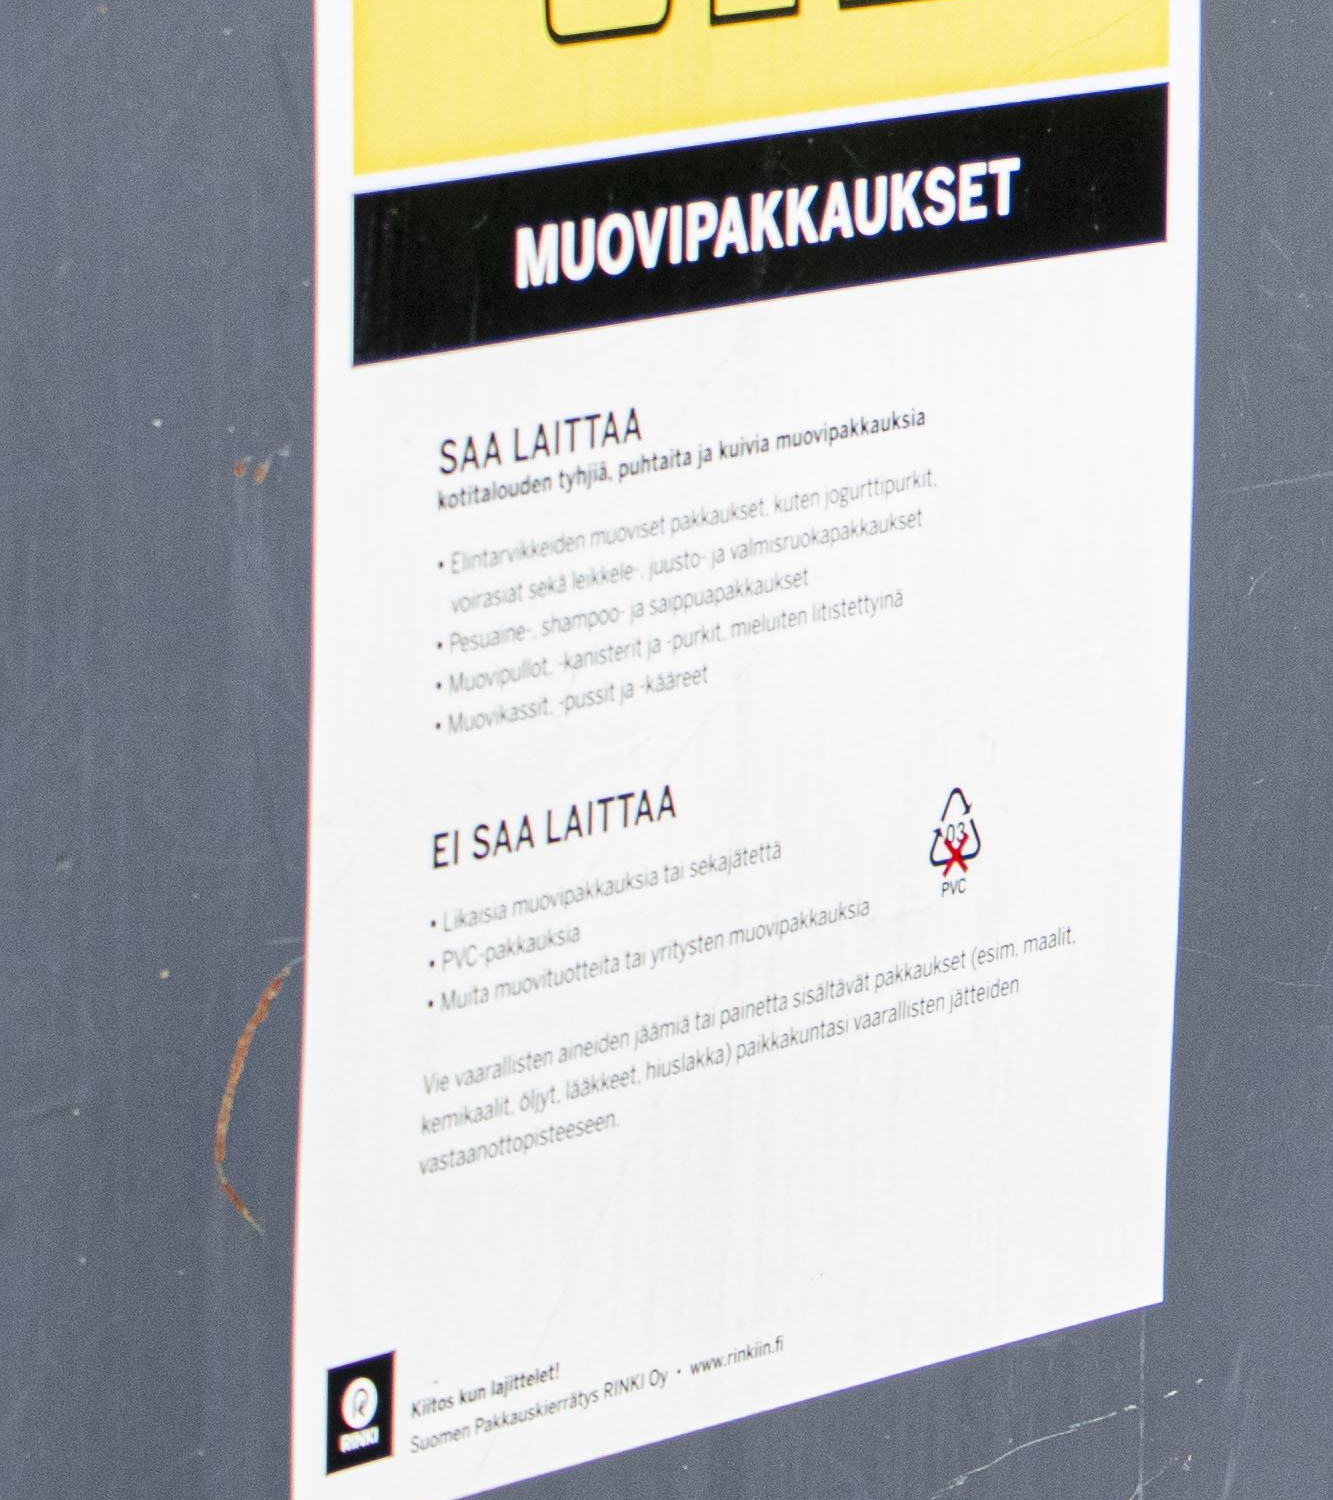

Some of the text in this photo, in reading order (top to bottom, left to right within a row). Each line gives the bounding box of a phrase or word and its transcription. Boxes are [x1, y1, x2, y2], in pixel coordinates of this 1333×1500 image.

[515, 156, 1021, 290] MUOVIPAKKAUKSET
[436, 407, 925, 511] kotitalouden tyhjiä, puhtaita ja kuivia muovipakkauksia
[438, 406, 642, 476] SAA LAITTAA
[449, 532, 585, 575] Elintarvikkeiden
[589, 514, 665, 547] muoviset
[773, 490, 820, 513] kuten
[541, 606, 624, 637] shampoo-
[630, 600, 644, 624] ja
[648, 567, 808, 616] saippuapakkaukset
[646, 636, 661, 660] ja
[729, 608, 807, 638] mieluiten
[811, 588, 903, 622] litistettyinä
[619, 681, 635, 705] ja
[431, 784, 676, 870] EI SAA LAITTAA
[441, 839, 782, 934] Likaisia muovipakkauksia tai sekajätettä
[941, 877, 967, 897] PVC
[439, 897, 870, 1012] Muita muovituotteita tai yritysten muovipakkauksia
[440, 925, 580, 972] PVC-pakkauksia
[421, 1072, 450, 1095] Vie
[454, 1049, 553, 1088] vaarallisten
[556, 1031, 630, 1064] aineiden
[633, 1014, 690, 1050] jäämiä
[693, 1007, 716, 1031] tai
[719, 992, 788, 1030] painetta
[791, 971, 870, 1008] sisältävät
[873, 949, 966, 993] pakkaukset
[970, 941, 1018, 970] (esim.
[645, 1041, 732, 1081] hiuslakka)
[735, 1018, 849, 1064] paikkakuntasi
[852, 994, 945, 1031] vaarallisten
[948, 977, 1019, 1014] jätteiden
[417, 1111, 619, 1176] vastaanottopisteeseen.
[408, 1334, 783, 1454] Suomen Pakkauskierrätys RINKI Oy www.rinkiin.fi
[409, 1360, 559, 1419] Kiitos kun lajittelet!
